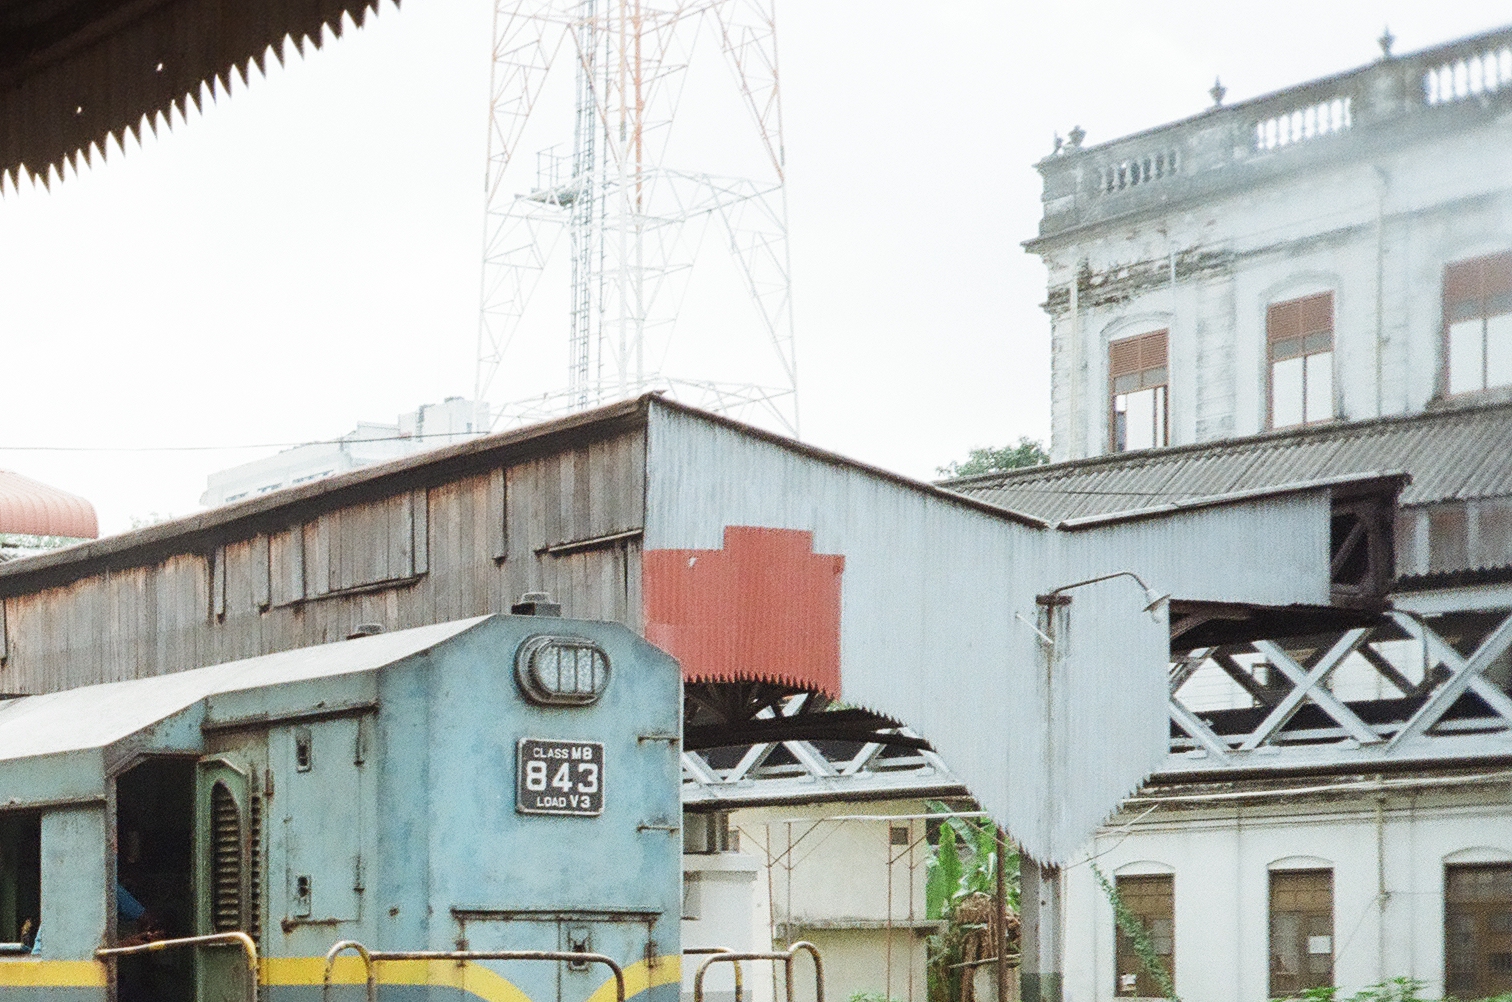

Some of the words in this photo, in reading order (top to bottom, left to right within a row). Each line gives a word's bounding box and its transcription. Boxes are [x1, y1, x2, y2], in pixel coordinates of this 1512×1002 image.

[533, 747, 569, 759] CLASS
[571, 746, 593, 760] M8
[525, 761, 598, 793] 843
[537, 796, 567, 808] LOAD
[570, 795, 591, 809] V3
